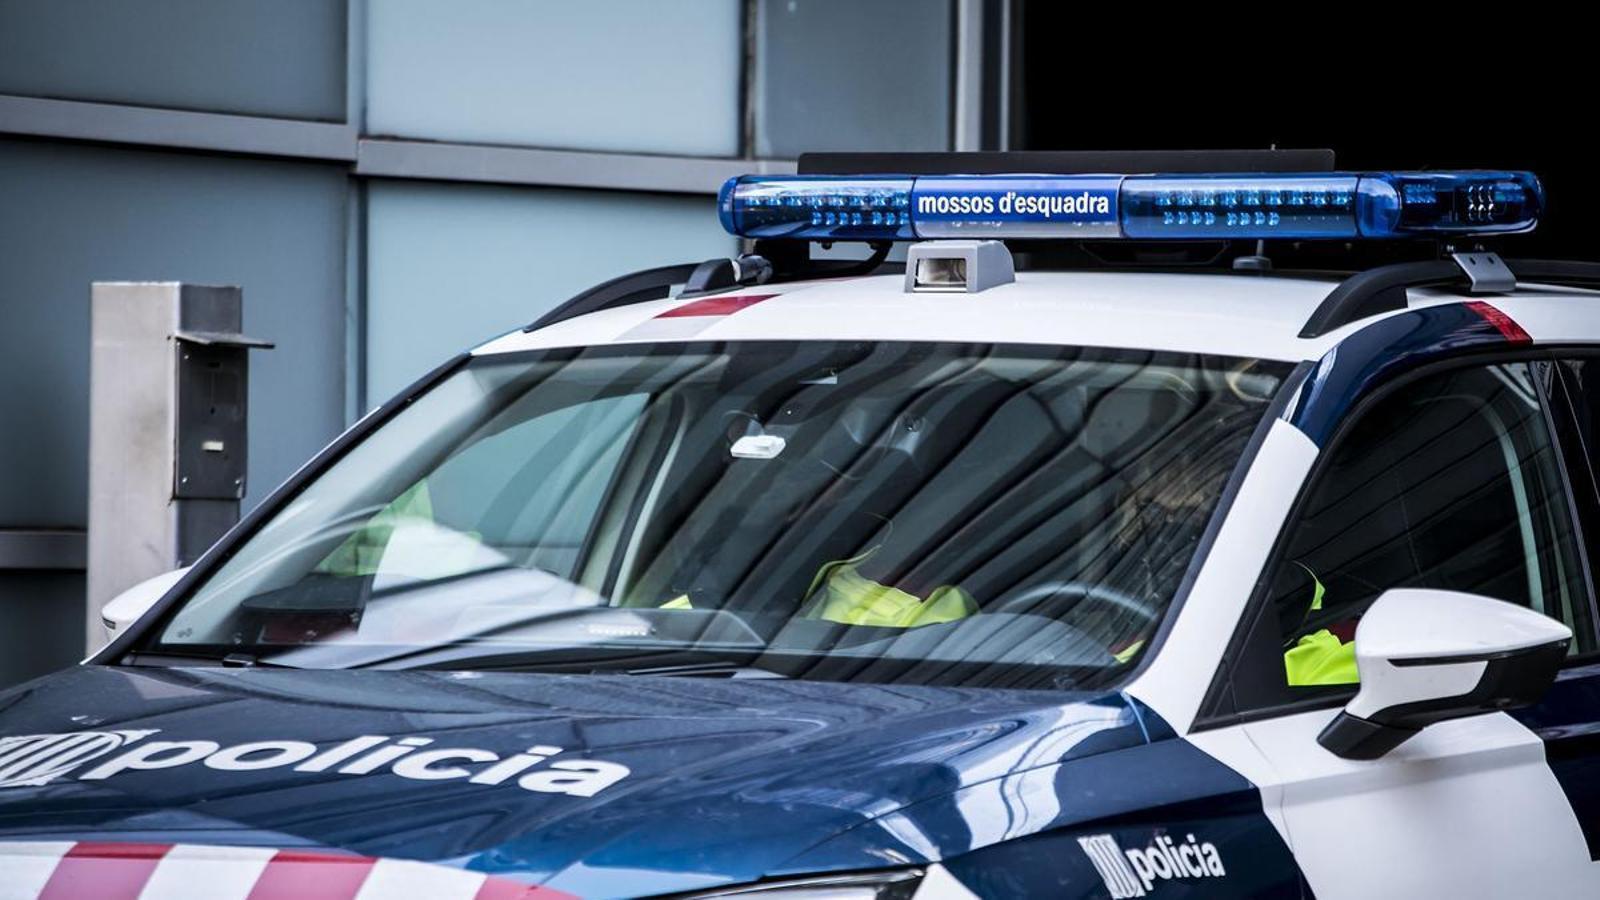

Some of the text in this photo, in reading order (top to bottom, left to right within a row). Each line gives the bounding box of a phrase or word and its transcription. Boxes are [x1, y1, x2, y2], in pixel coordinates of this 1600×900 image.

[918, 196, 994, 214] mossos
[79, 735, 631, 797] policia
[1125, 834, 1226, 891] policia
